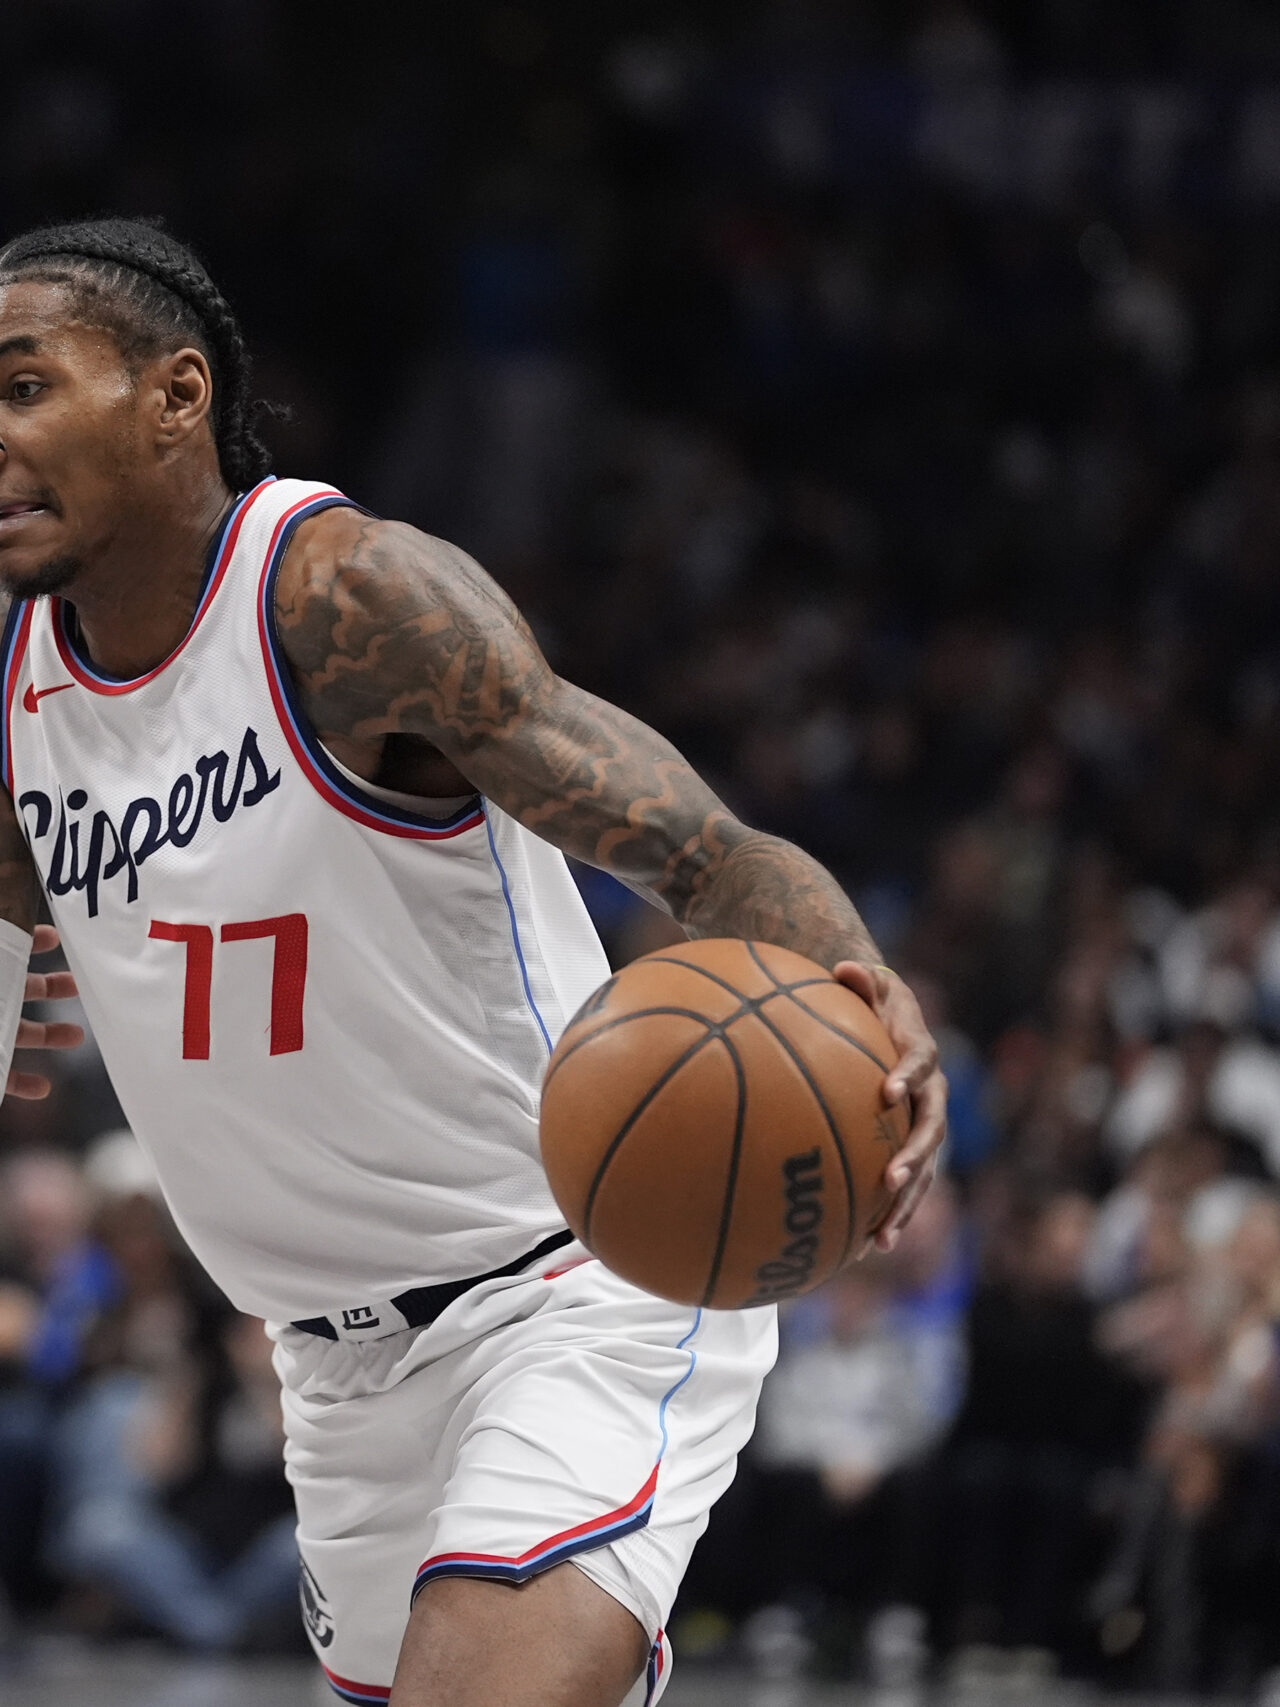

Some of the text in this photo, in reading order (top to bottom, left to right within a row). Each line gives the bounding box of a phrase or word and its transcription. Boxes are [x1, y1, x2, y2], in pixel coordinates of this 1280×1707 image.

[19, 727, 281, 918] Clippers
[148, 913, 308, 1060] 77
[746, 1146, 823, 1303] ilson
